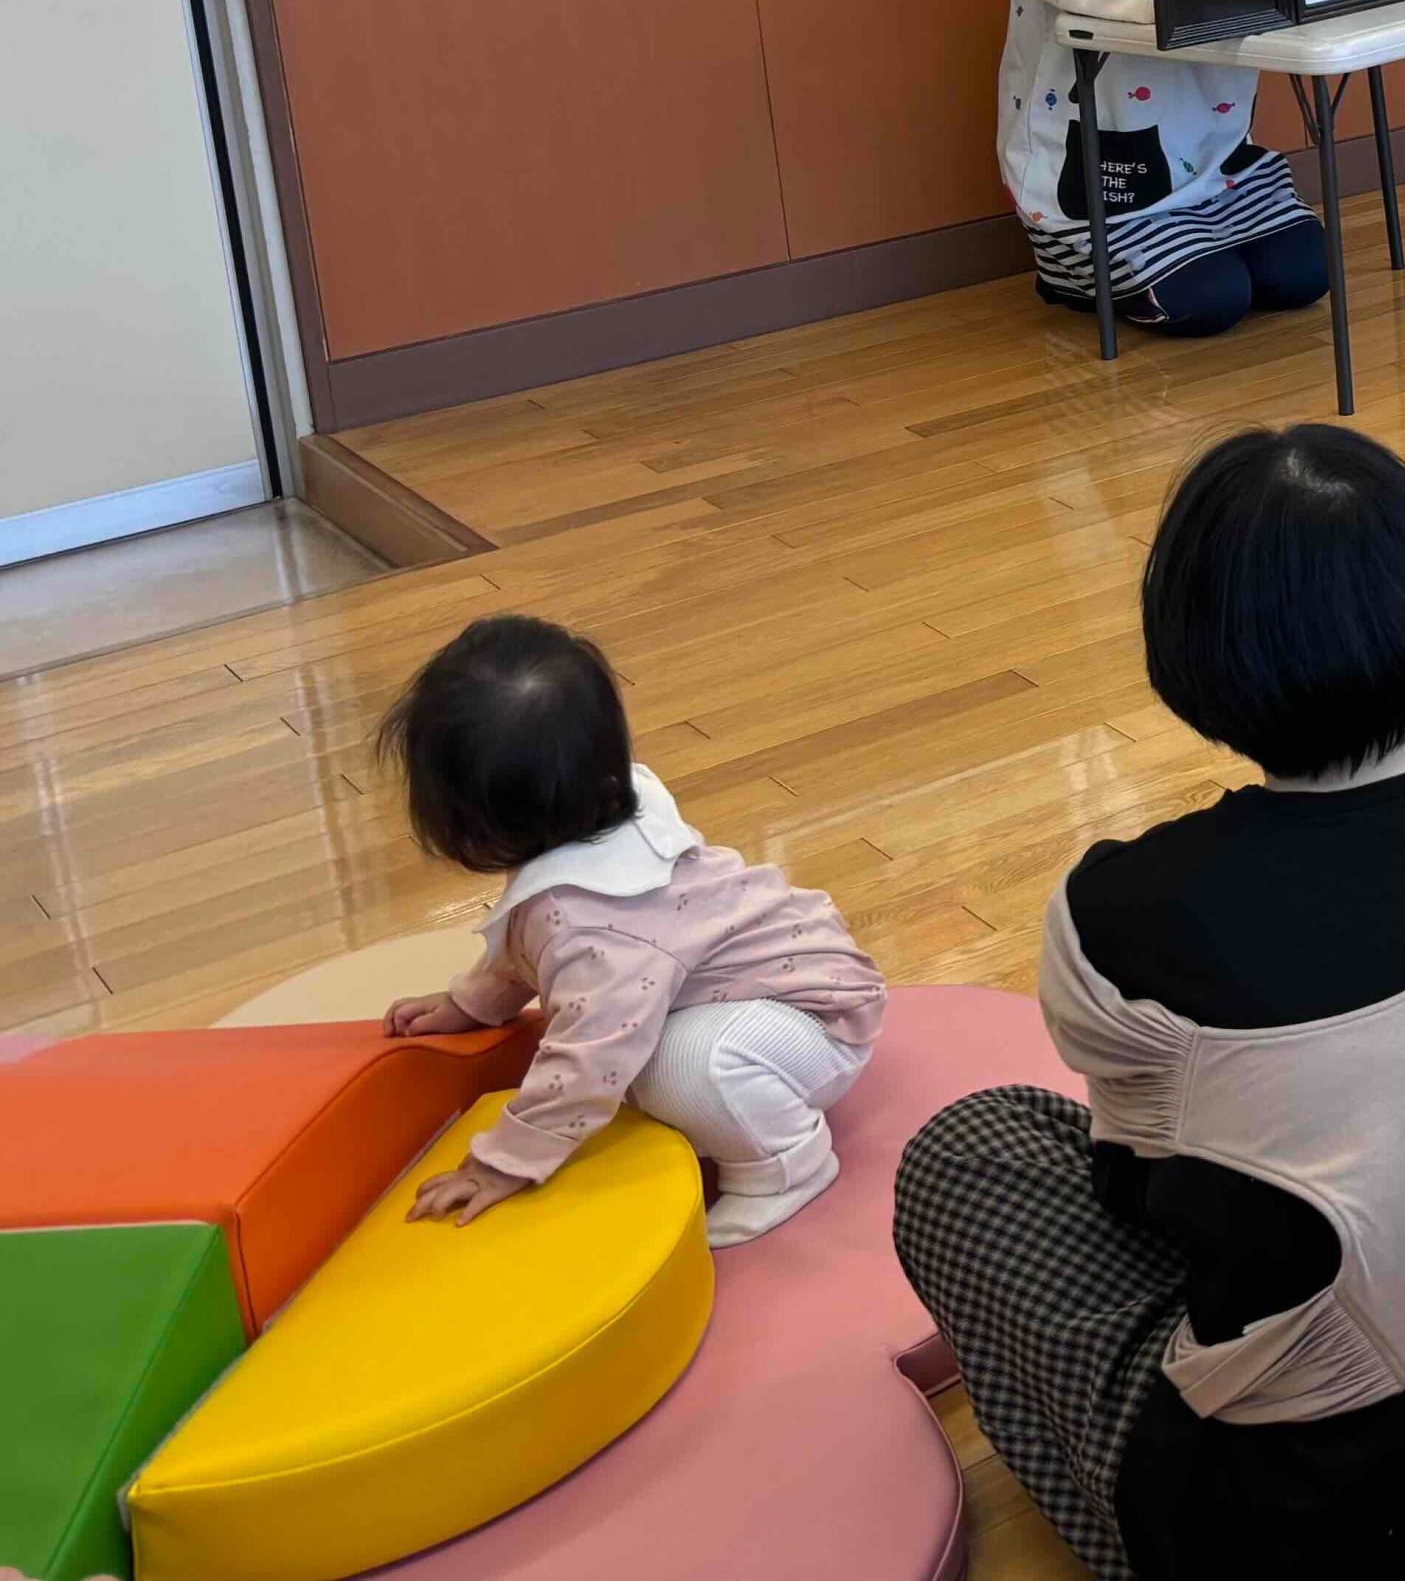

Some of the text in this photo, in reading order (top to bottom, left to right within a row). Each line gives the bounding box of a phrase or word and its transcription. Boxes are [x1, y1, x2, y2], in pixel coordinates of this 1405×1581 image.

[1099, 160, 1148, 174] HERE'S
[1102, 175, 1127, 189] THE
[1103, 190, 1135, 203] ISH?
